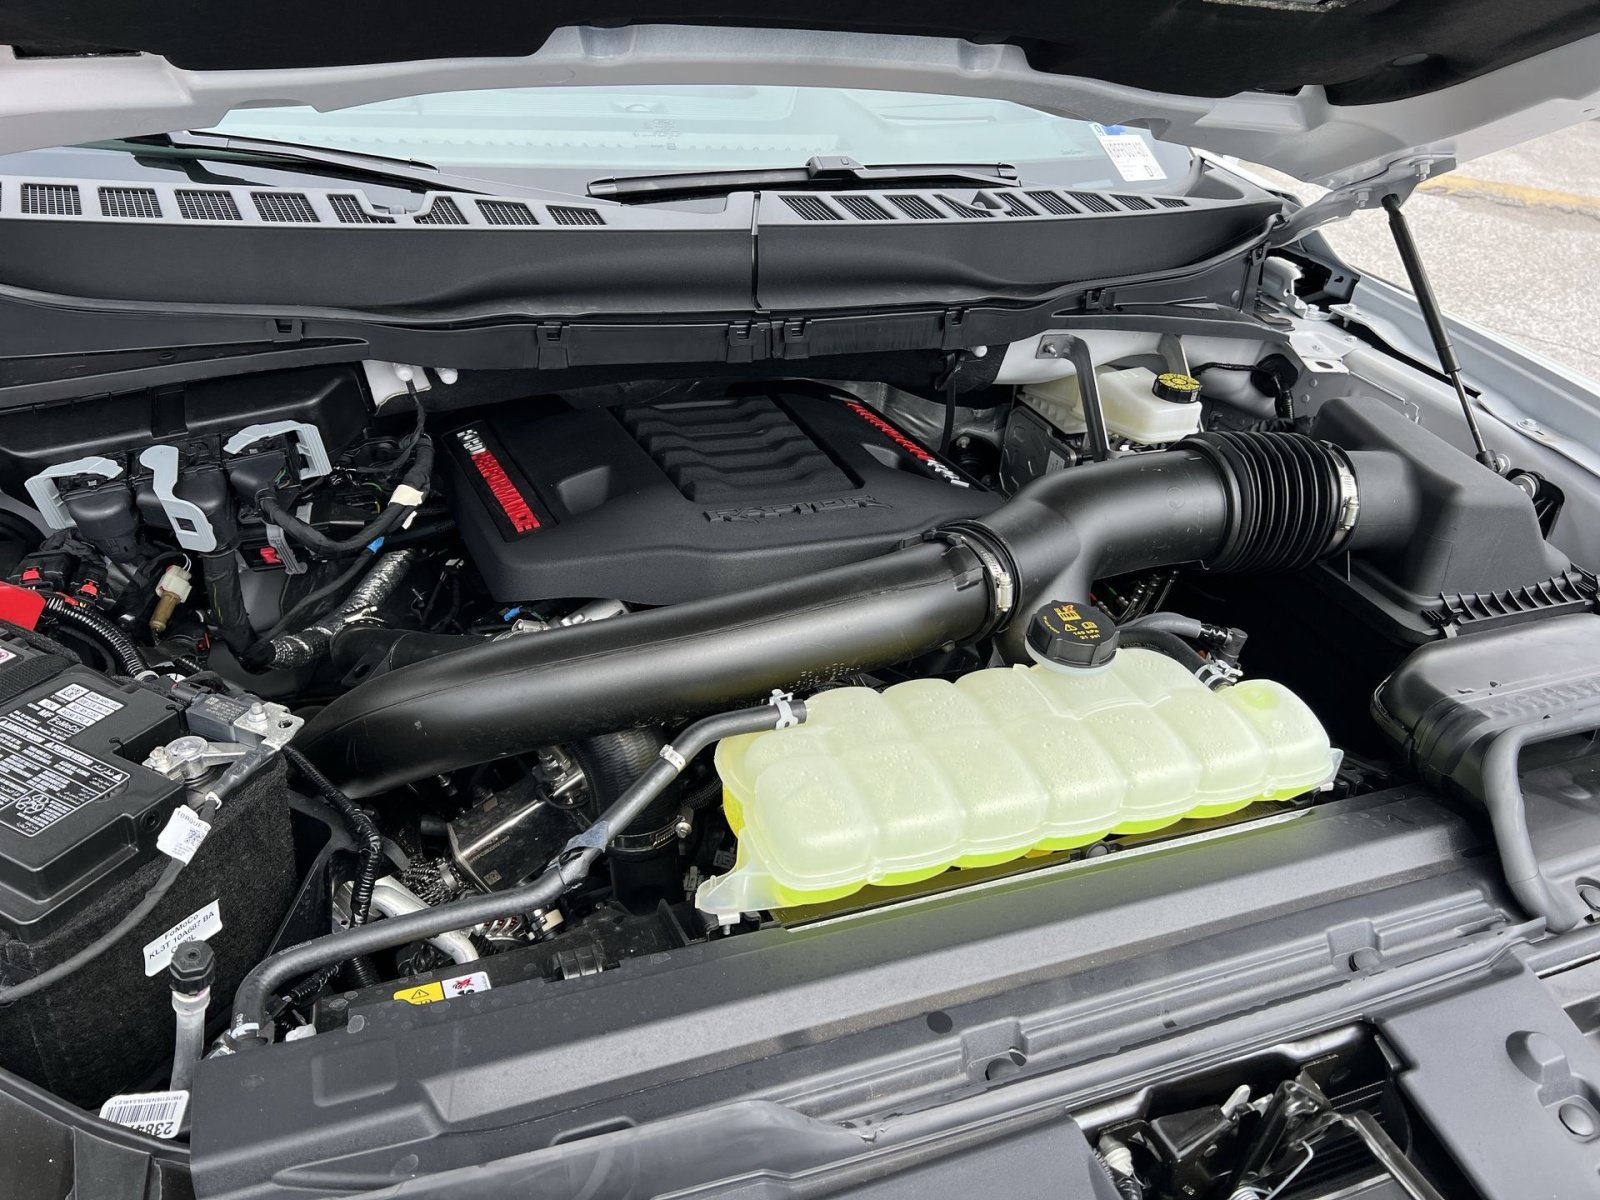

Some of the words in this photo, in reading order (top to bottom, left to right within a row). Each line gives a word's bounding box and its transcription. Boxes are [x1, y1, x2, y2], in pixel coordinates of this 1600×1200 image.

[470, 449, 541, 533] PERFORMANCE
[49, 717, 80, 732] FoMoCo
[164, 914, 199, 940] FoMoCo
[203, 911, 215, 923] BA
